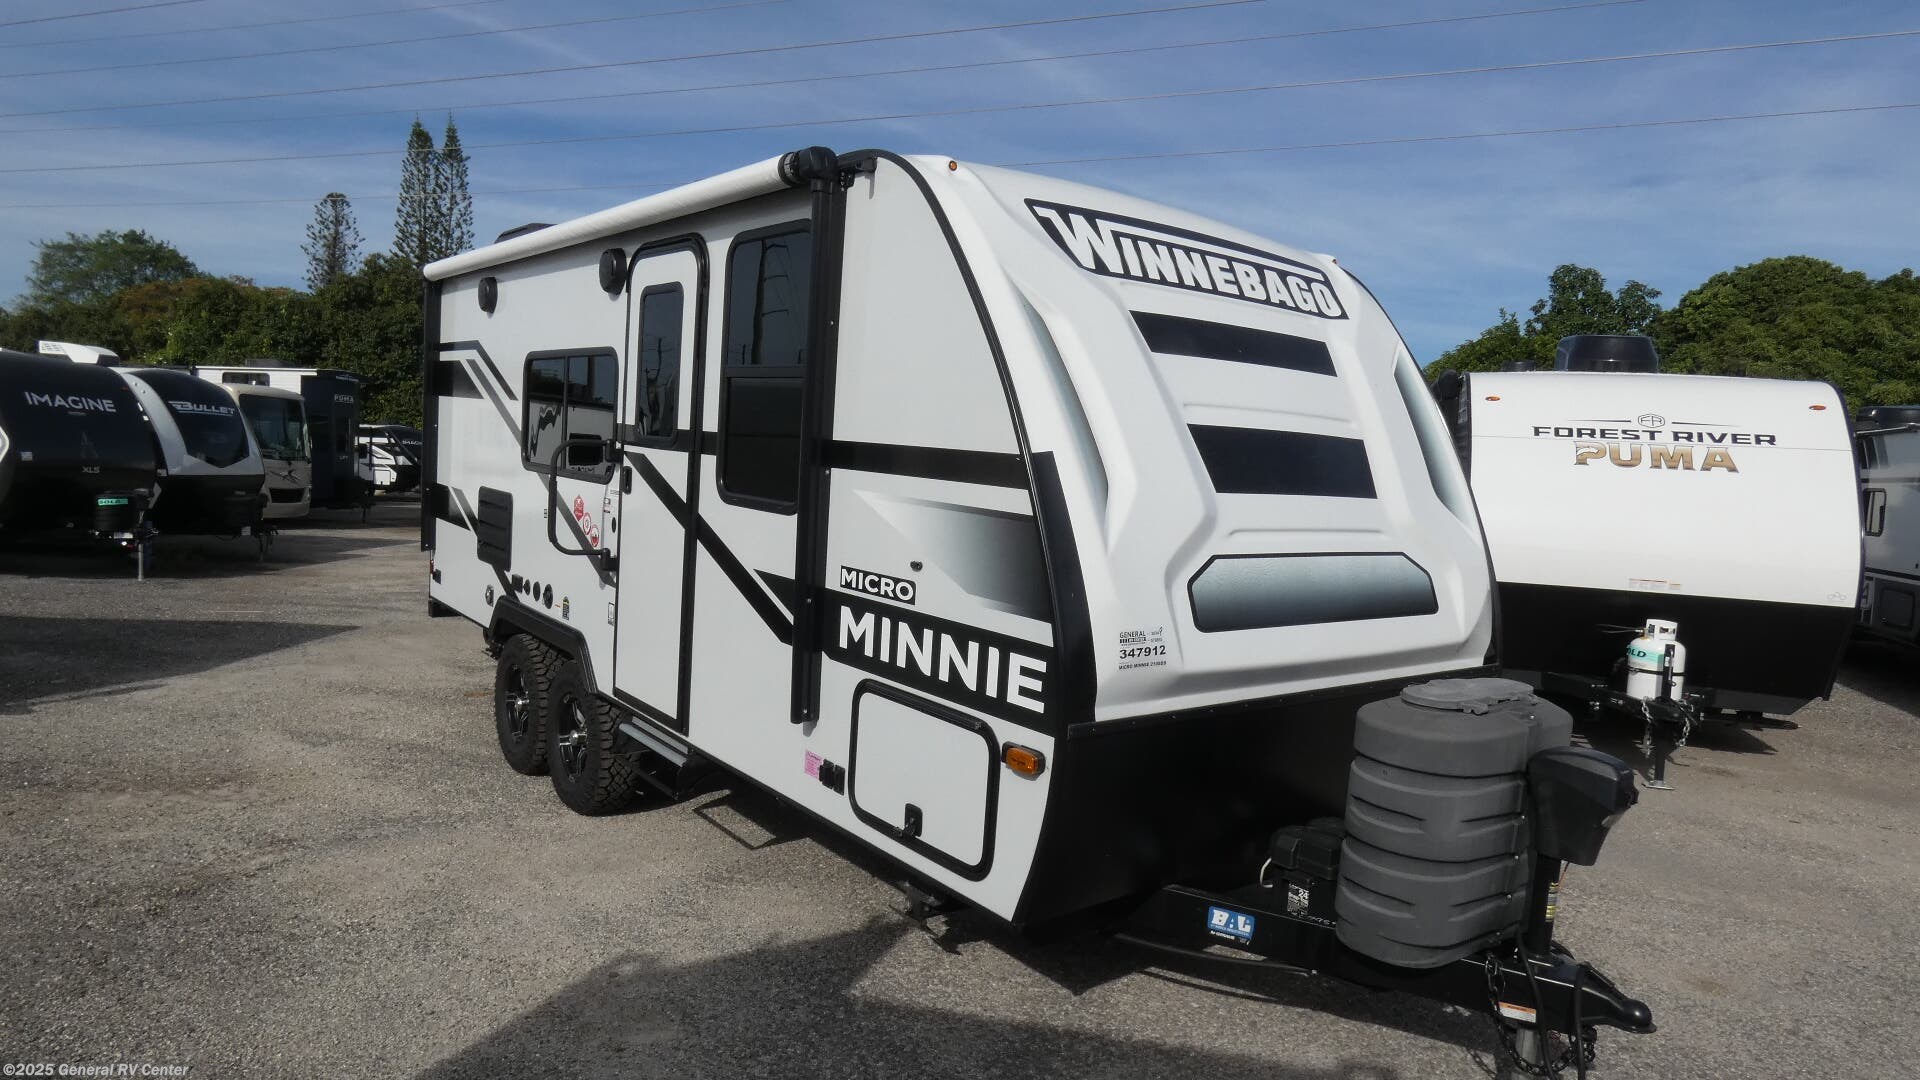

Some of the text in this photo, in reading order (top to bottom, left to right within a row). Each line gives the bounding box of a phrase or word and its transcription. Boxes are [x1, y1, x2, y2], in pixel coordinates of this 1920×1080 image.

[1032, 205, 1342, 317] WINNEBAGO
[24, 391, 117, 413] IMAGINE
[168, 401, 235, 415] BULLET
[1533, 425, 1777, 446] FOREST RIVER
[1573, 441, 1739, 473] PUMA
[82, 466, 100, 474] XLS
[840, 568, 914, 601] MICRO
[1120, 630, 1145, 638] GENERAL
[839, 605, 1047, 714] MINNIE
[1120, 645, 1166, 659] 347912
